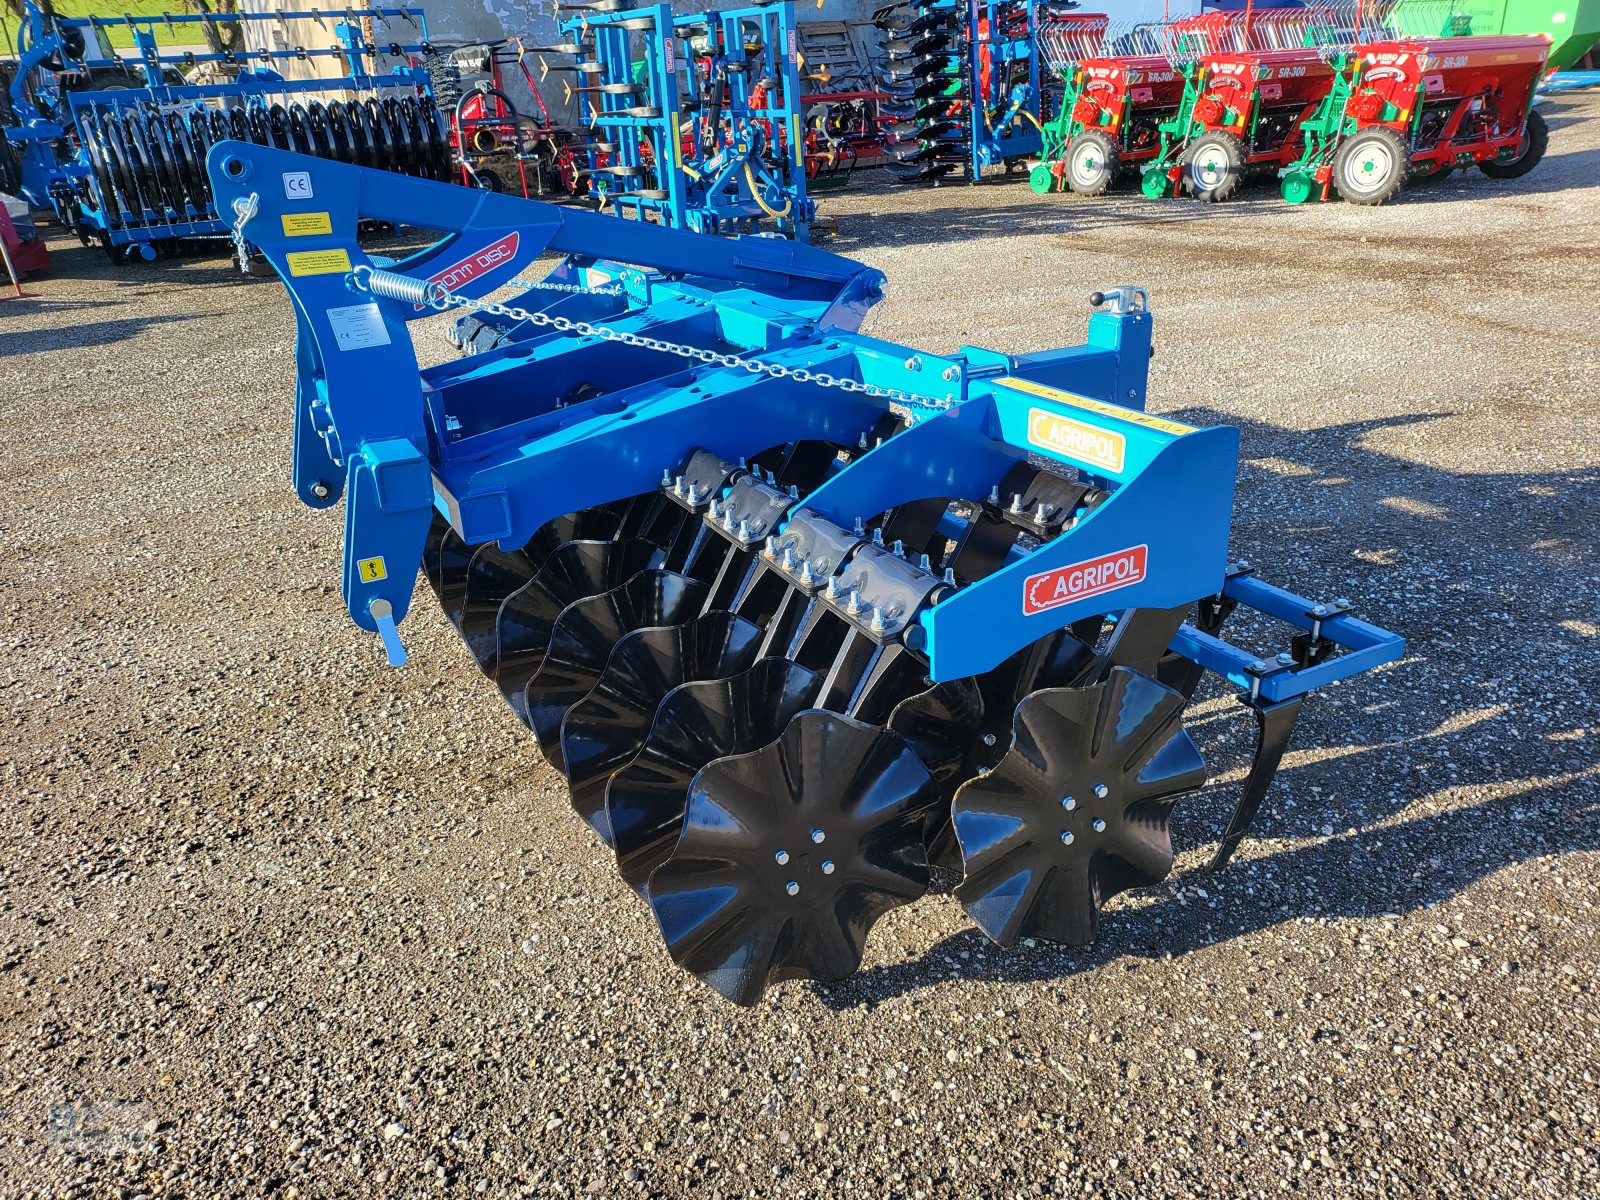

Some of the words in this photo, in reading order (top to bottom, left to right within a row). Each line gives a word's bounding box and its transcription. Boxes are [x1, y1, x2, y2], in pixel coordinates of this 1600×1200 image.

[1376, 53, 1398, 62] AGRO
[1442, 55, 1469, 69] SR-300
[1147, 71, 1175, 83] SR-300
[1277, 66, 1307, 78] SR-300
[476, 245, 511, 269] DISC
[1048, 423, 1118, 461] AGRIPOL
[1053, 555, 1140, 597] AGRIPOL
